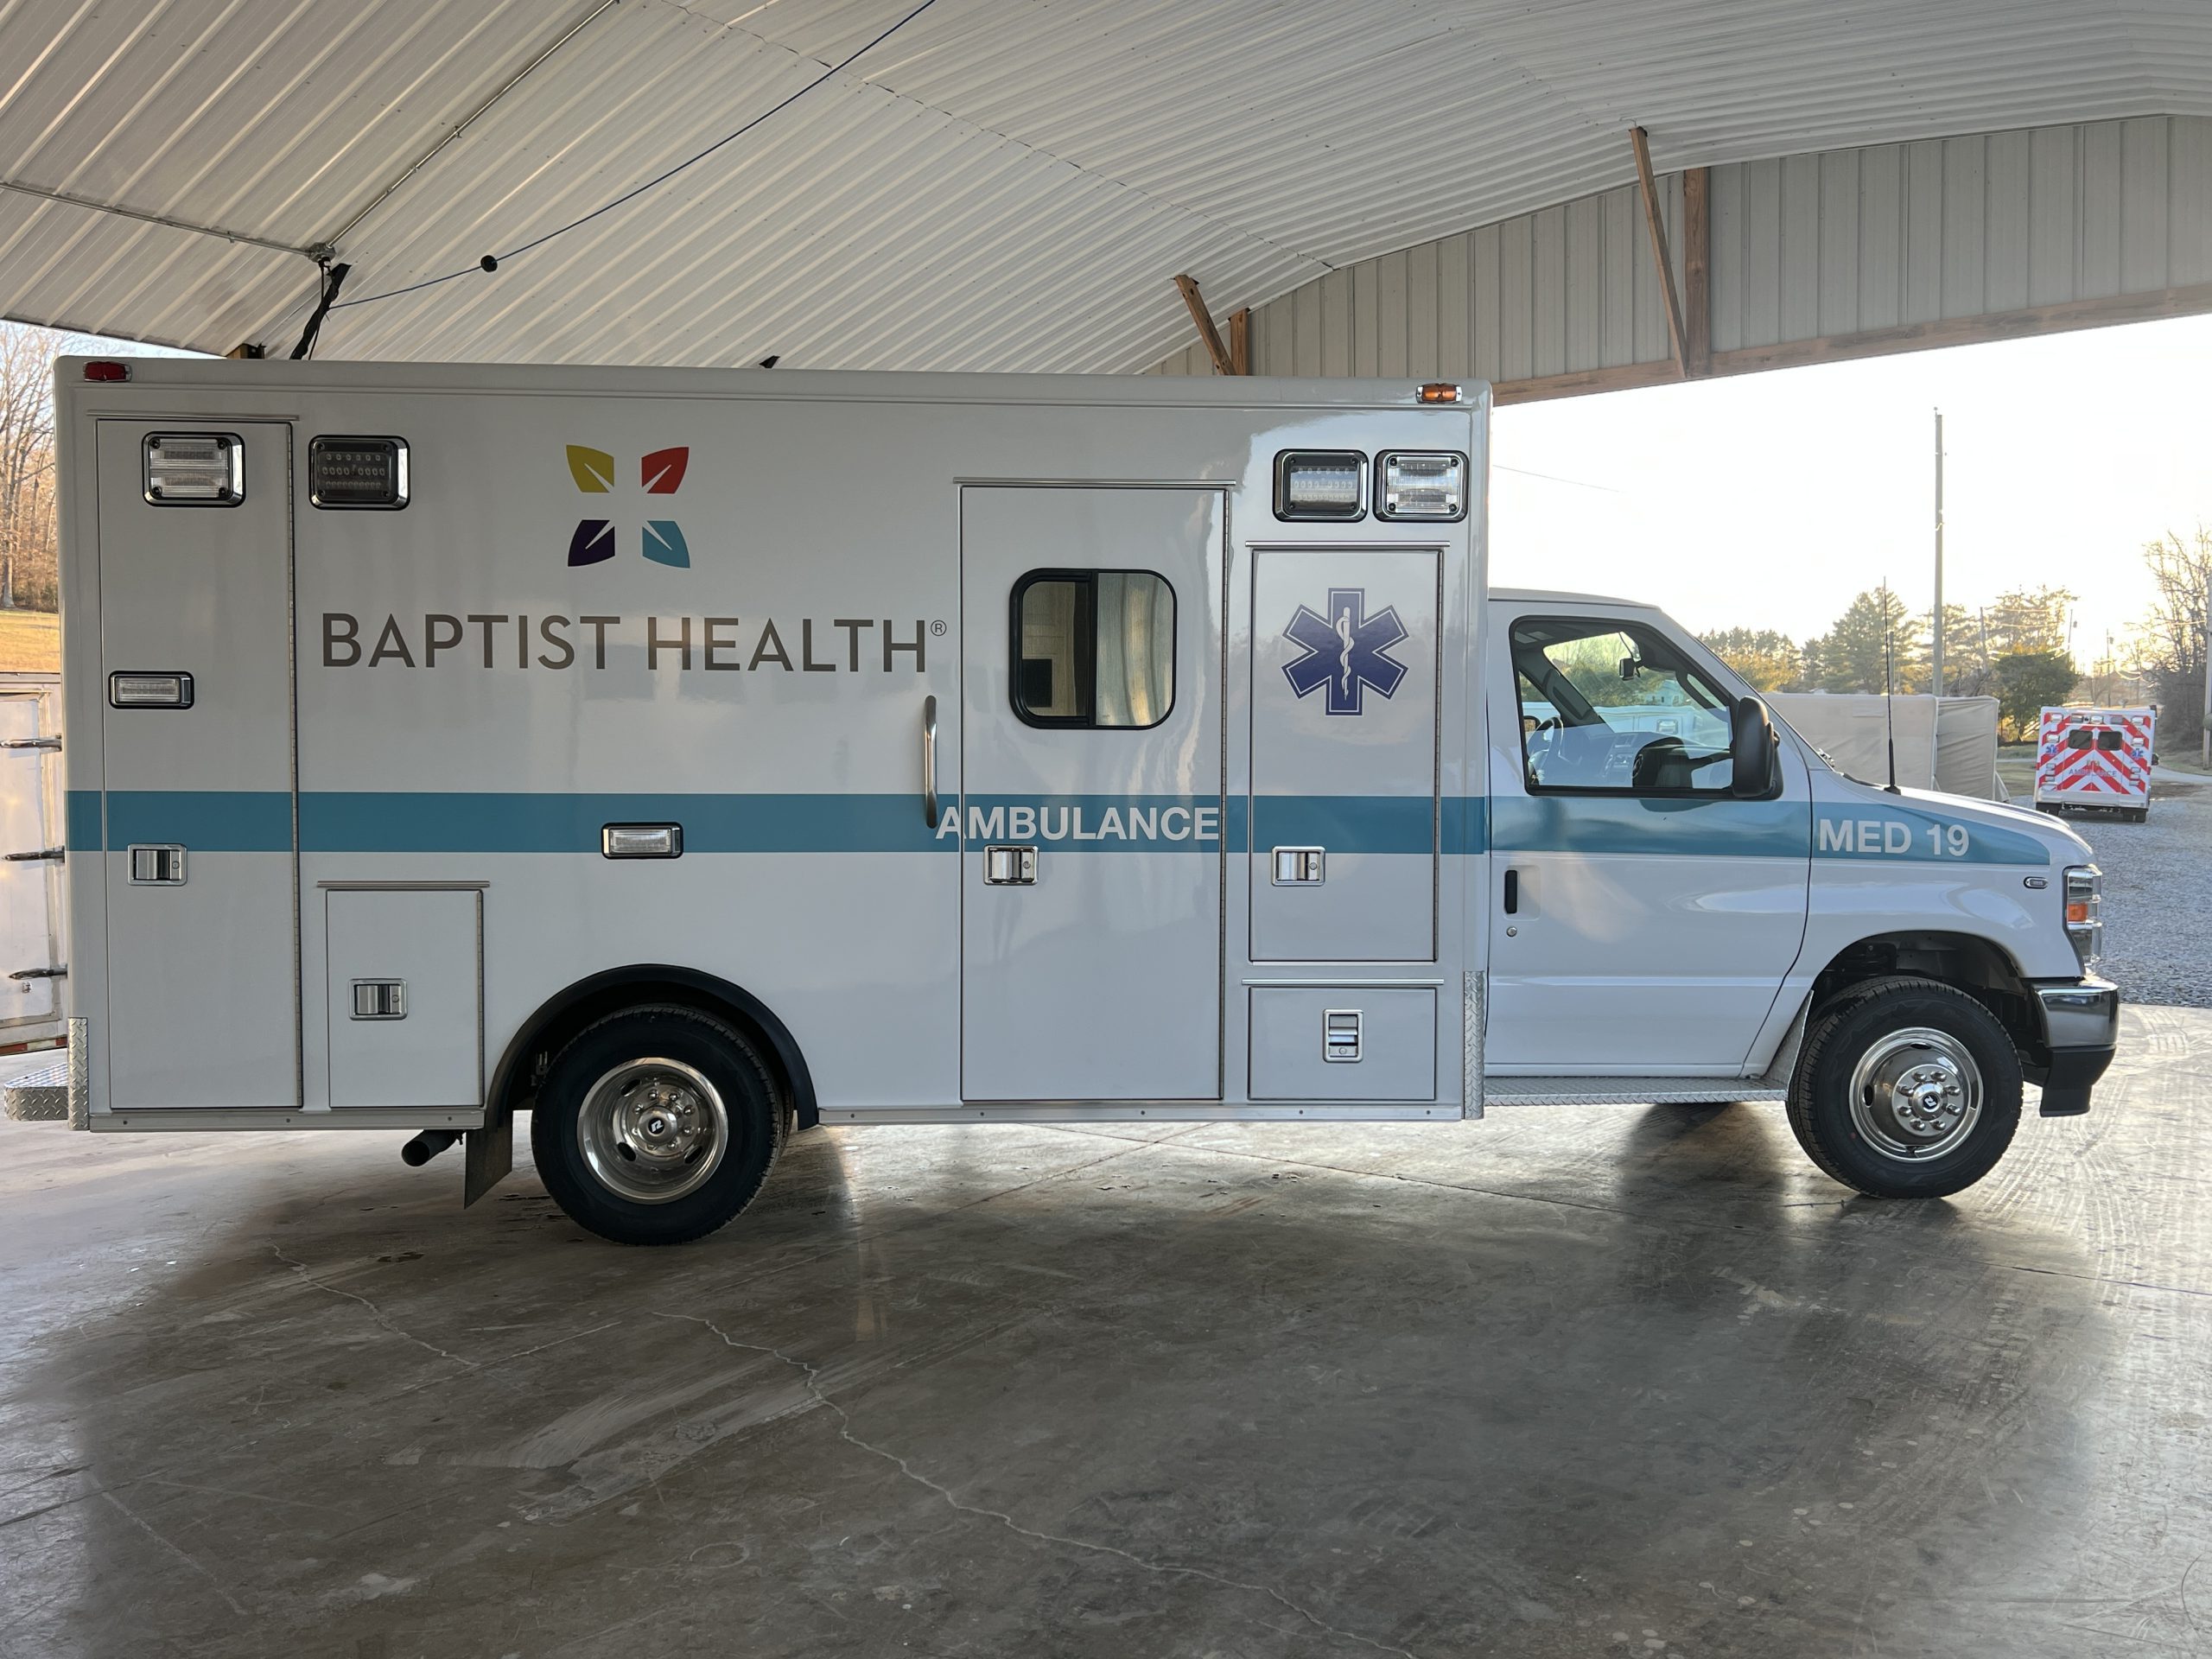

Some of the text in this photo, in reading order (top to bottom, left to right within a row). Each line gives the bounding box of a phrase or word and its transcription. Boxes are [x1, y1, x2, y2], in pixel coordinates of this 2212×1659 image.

[322, 613, 620, 670] BAPTIST
[935, 806, 1220, 841] AMBULANCE
[1819, 818, 1970, 856] MED 19
